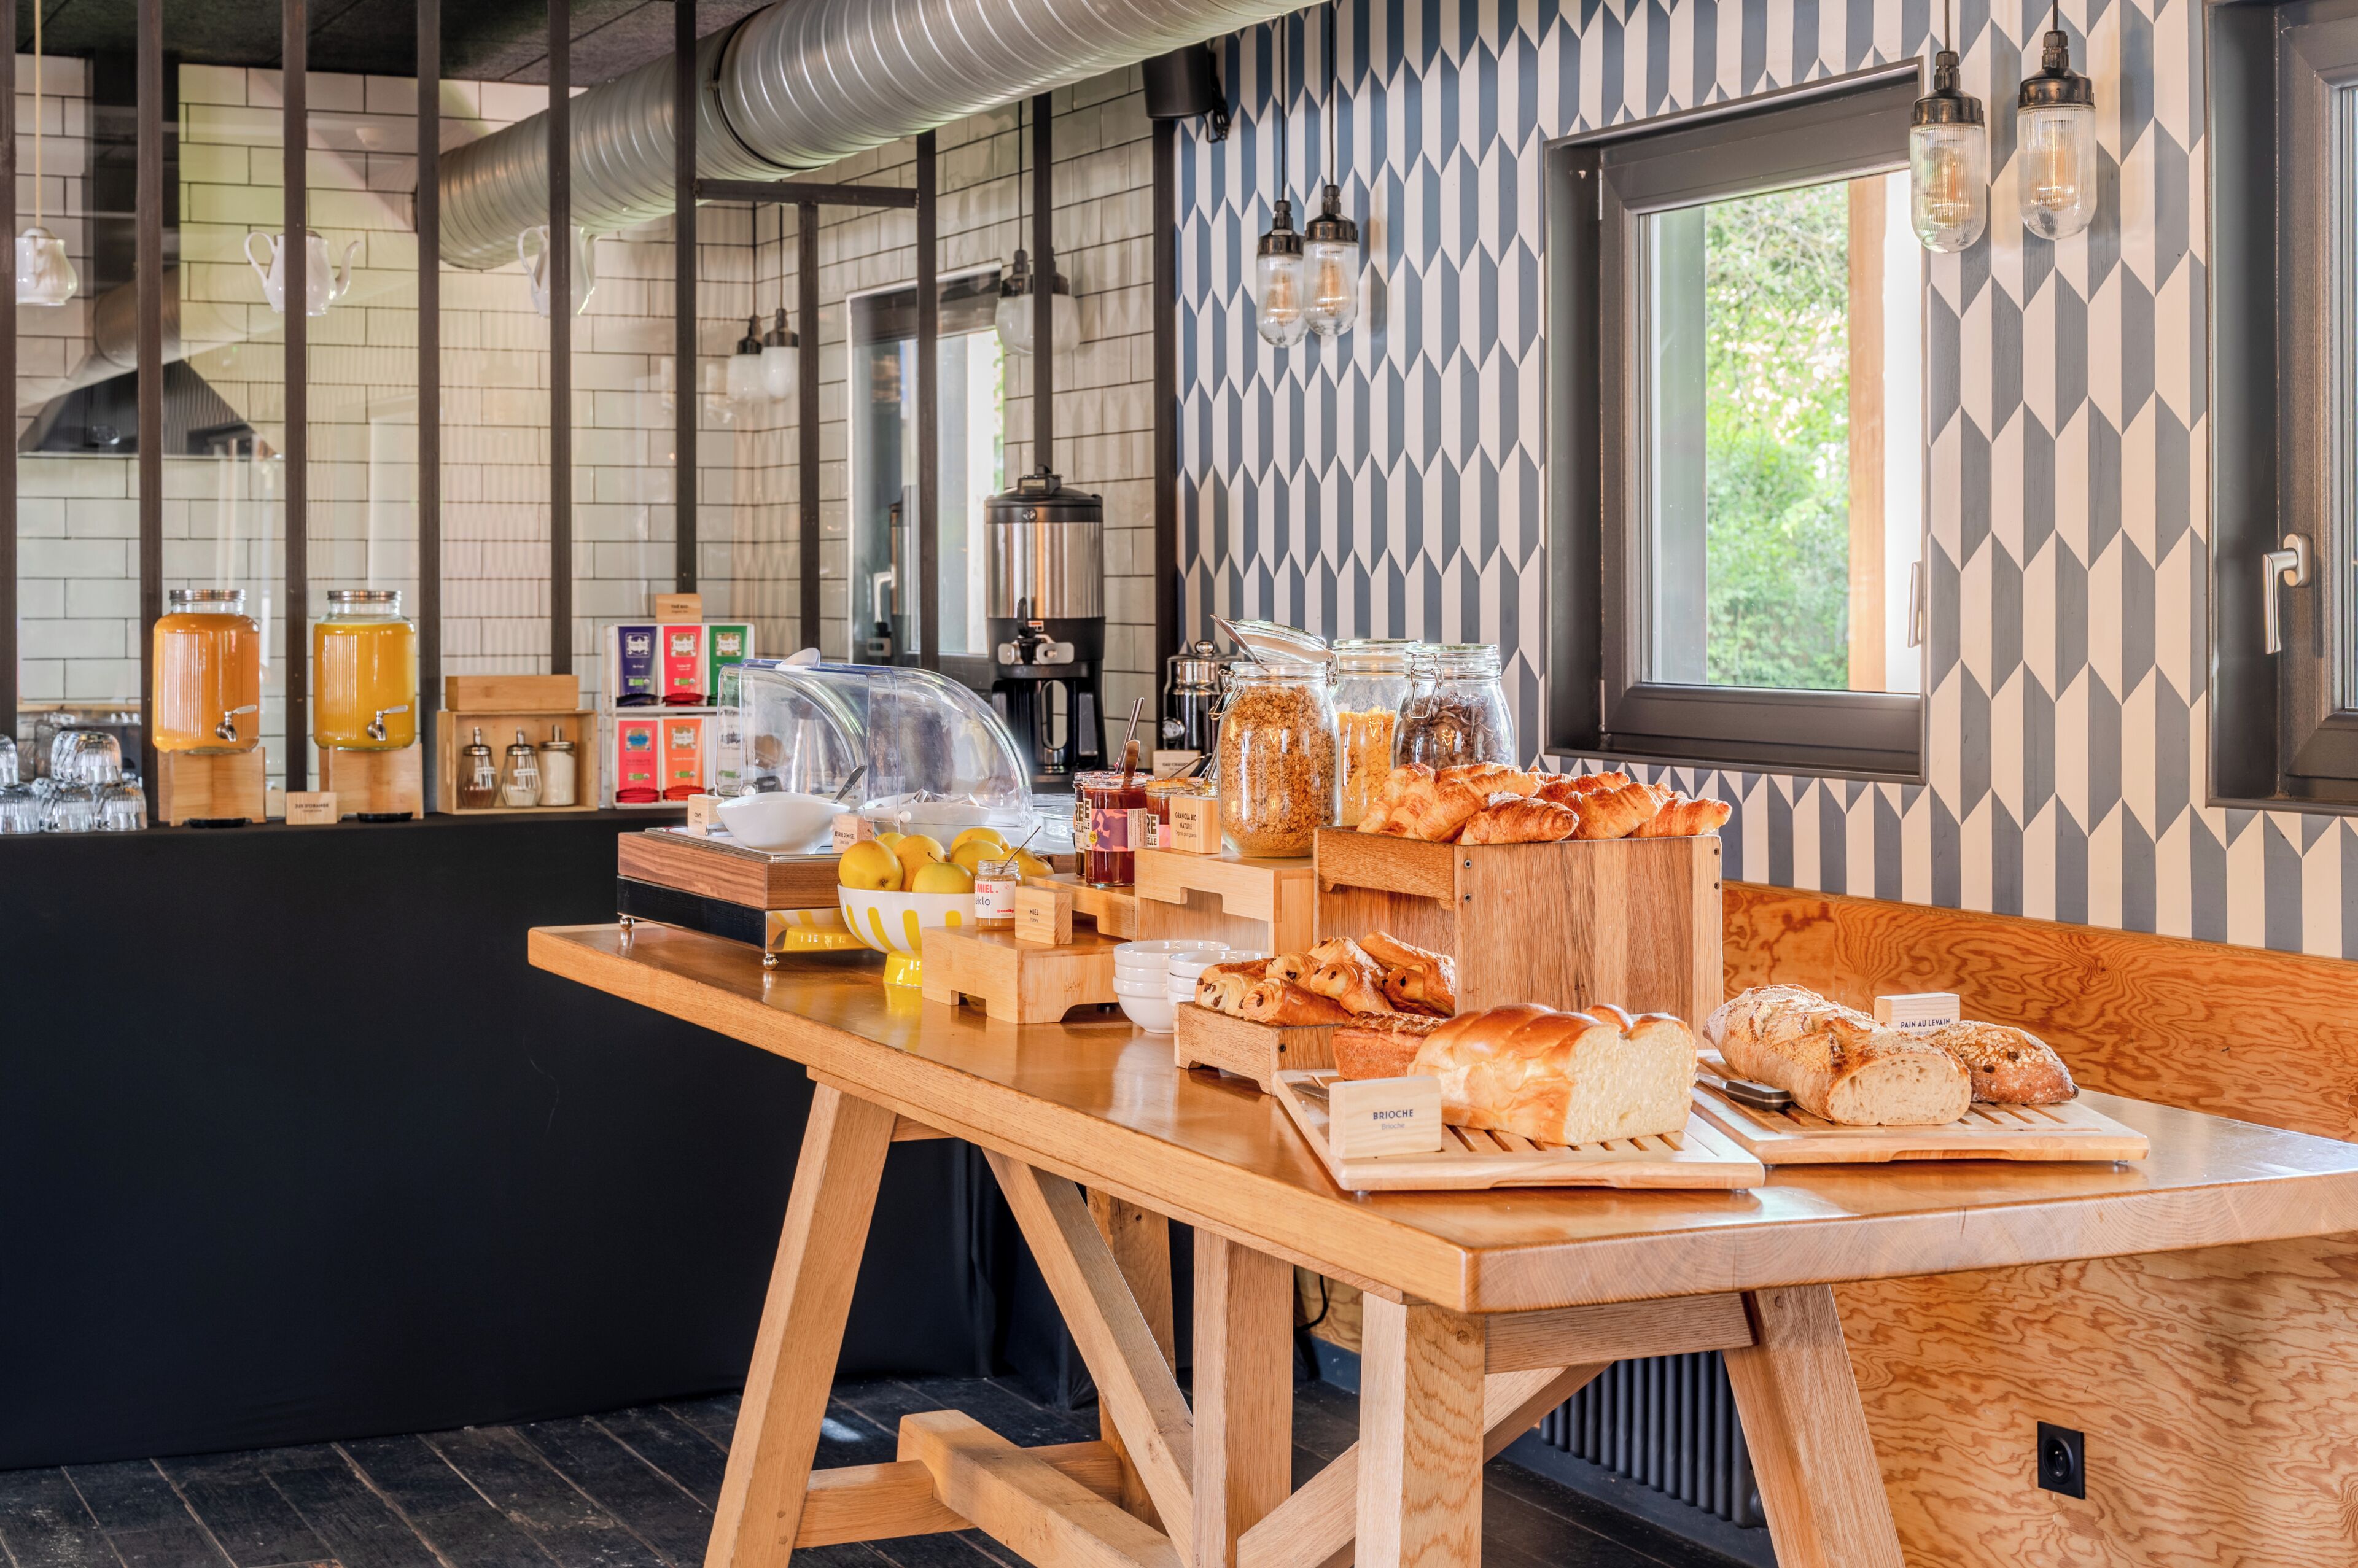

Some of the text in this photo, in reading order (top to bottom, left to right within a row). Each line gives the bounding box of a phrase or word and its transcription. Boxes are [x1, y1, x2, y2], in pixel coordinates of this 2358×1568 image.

[1175, 812, 1190, 820] GRANOLA
[977, 883, 994, 893] MIEL
[1928, 1018, 1950, 1027] LEVAIN
[1373, 1109, 1414, 1120] BRIOCHE
